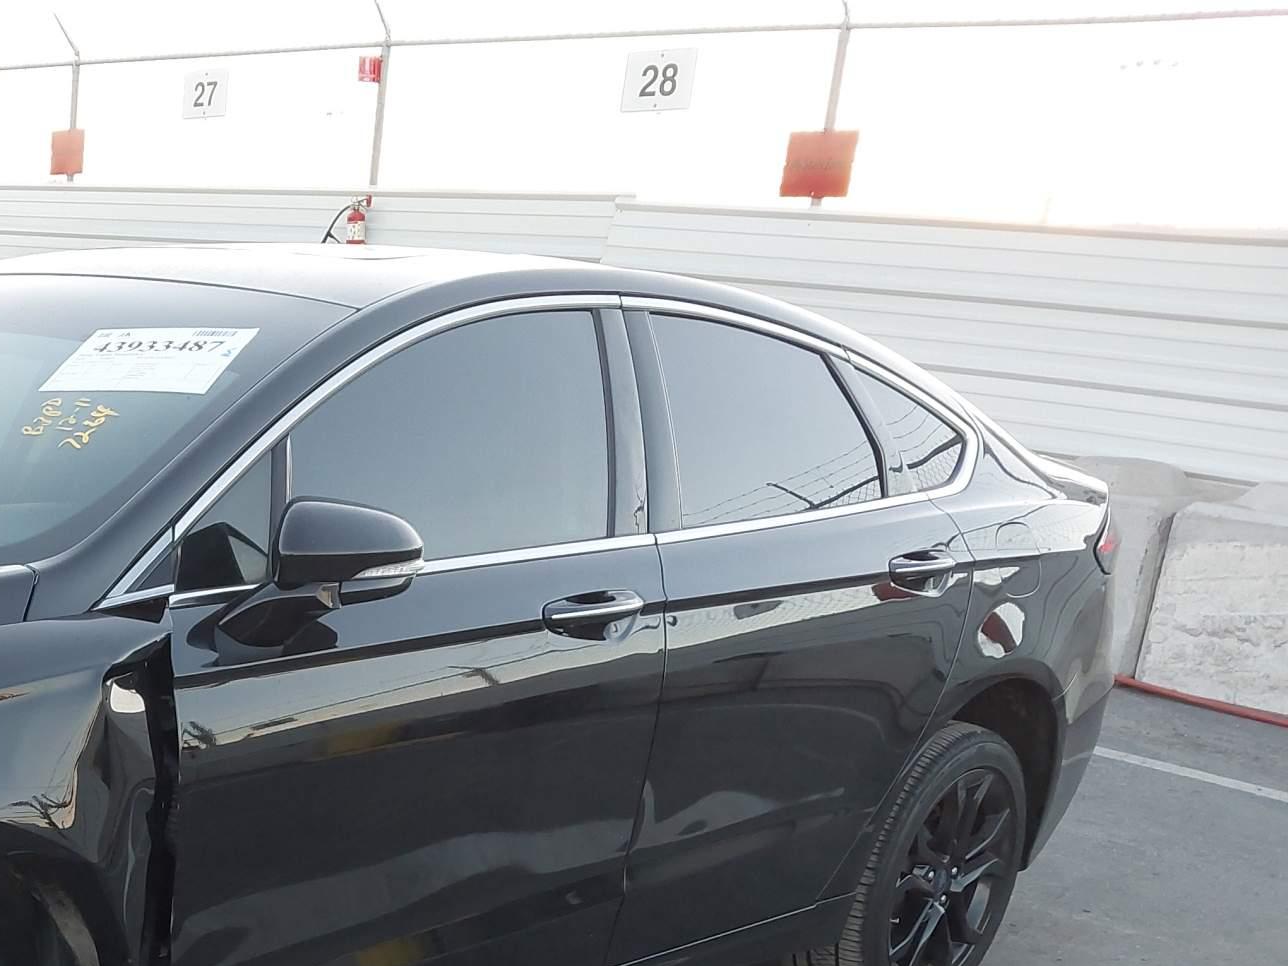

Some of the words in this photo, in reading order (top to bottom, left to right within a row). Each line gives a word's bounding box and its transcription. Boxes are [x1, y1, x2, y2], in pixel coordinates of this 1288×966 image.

[638, 63, 679, 98] 28
[193, 81, 219, 108] 27
[92, 340, 226, 354] 43933487
